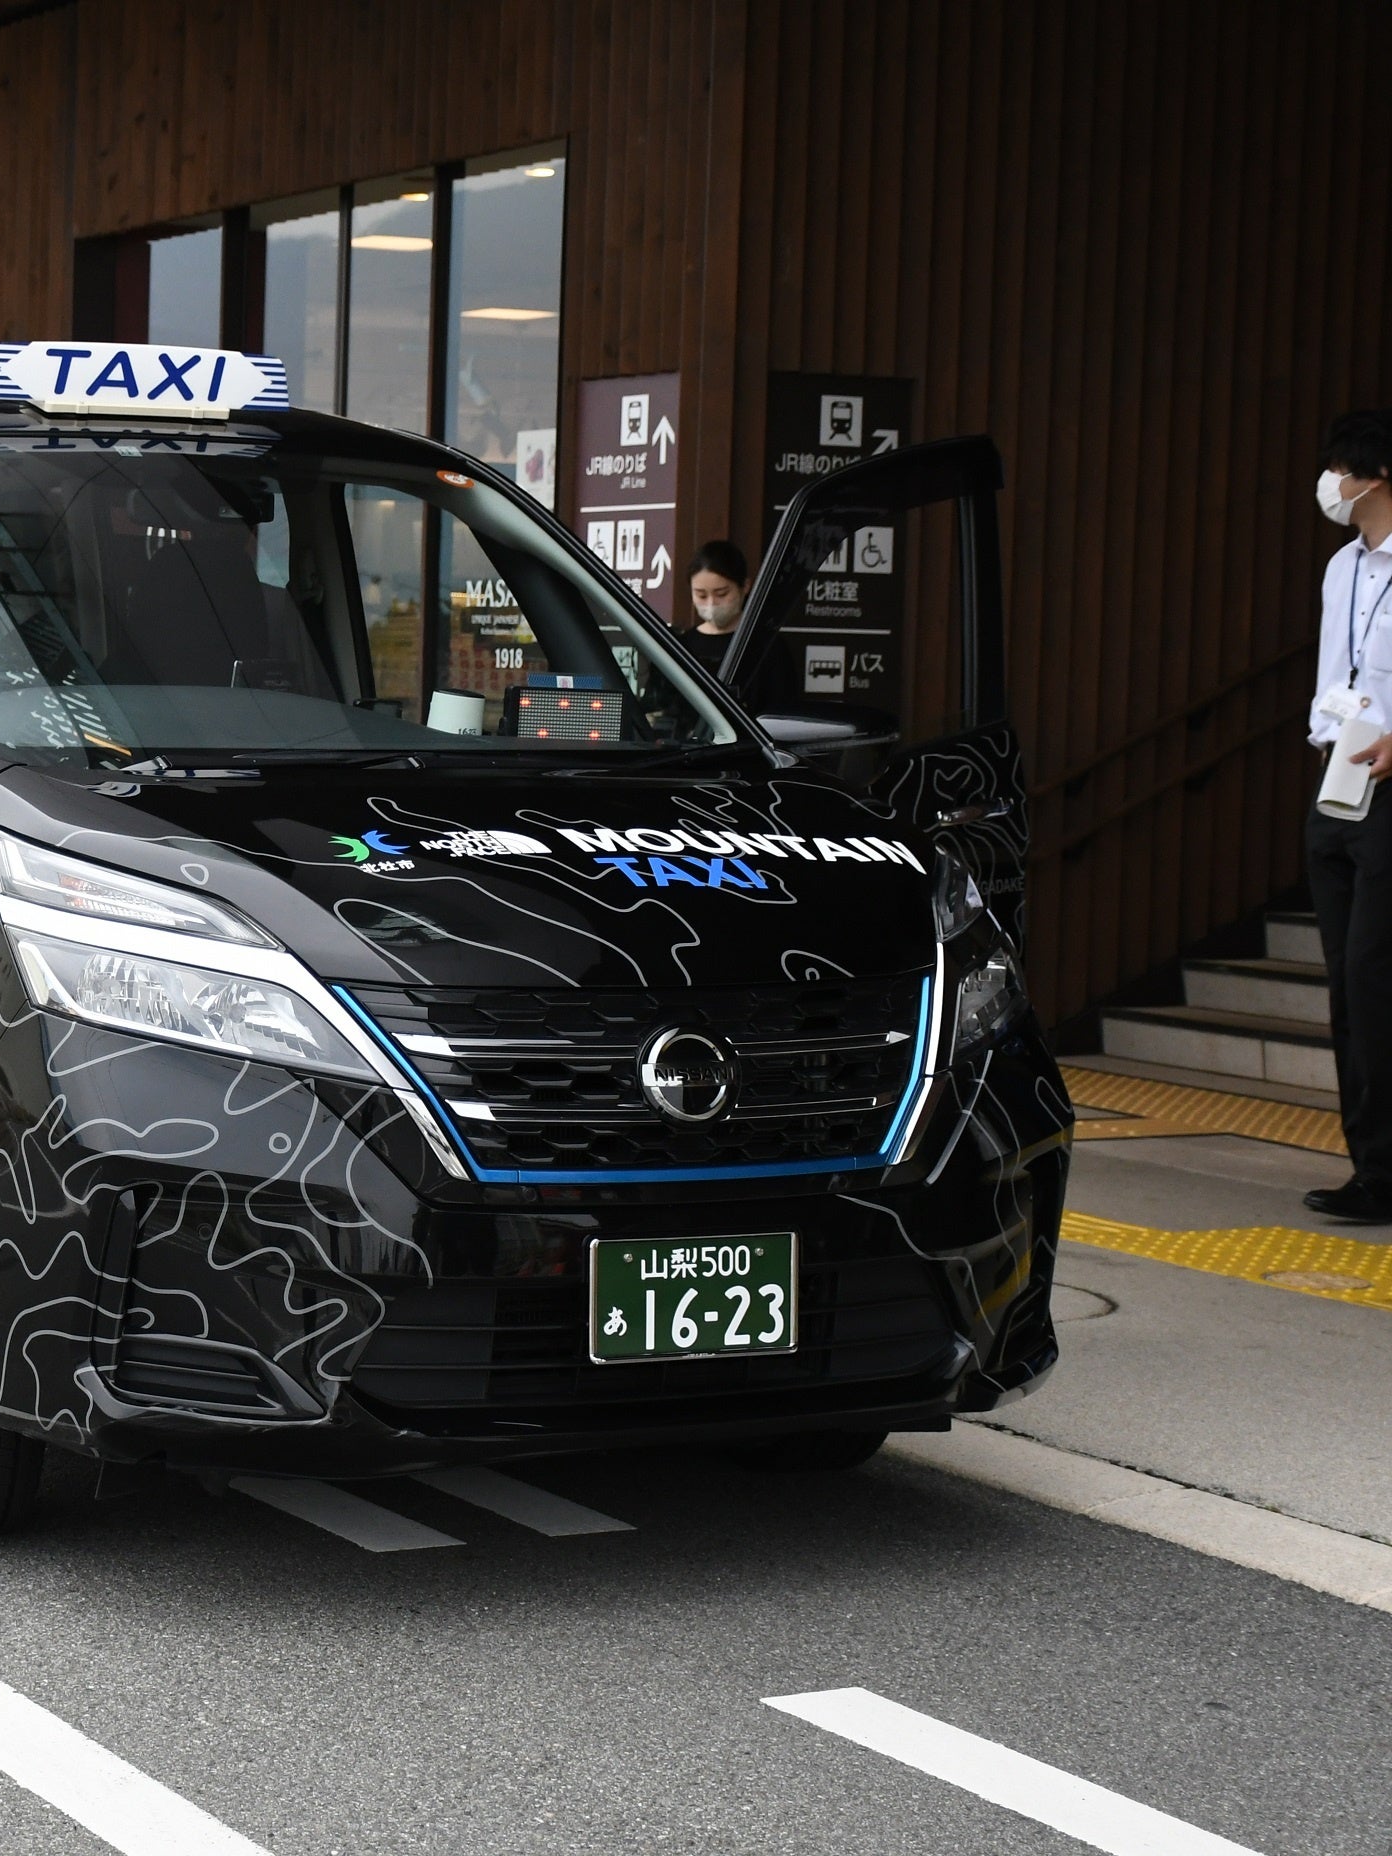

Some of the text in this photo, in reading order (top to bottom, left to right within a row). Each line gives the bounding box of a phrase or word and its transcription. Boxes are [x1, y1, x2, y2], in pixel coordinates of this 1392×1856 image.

[45, 348, 226, 402] TAXI
[586, 452, 647, 475] JR線のりば
[806, 580, 859, 601] 化粧室
[805, 603, 862, 617] Restrooms
[495, 647, 523, 669] 1918
[850, 652, 884, 673] バス
[849, 676, 870, 688] Bus
[419, 839, 498, 851] NORTH
[444, 830, 488, 840] THE
[454, 846, 512, 857] FACE
[557, 828, 926, 875] MOUNTAIN
[359, 859, 416, 873] 北杜市
[594, 857, 768, 889] TAXI
[654, 1065, 728, 1083] NISSAN
[603, 1283, 785, 1351] あ 16-23
